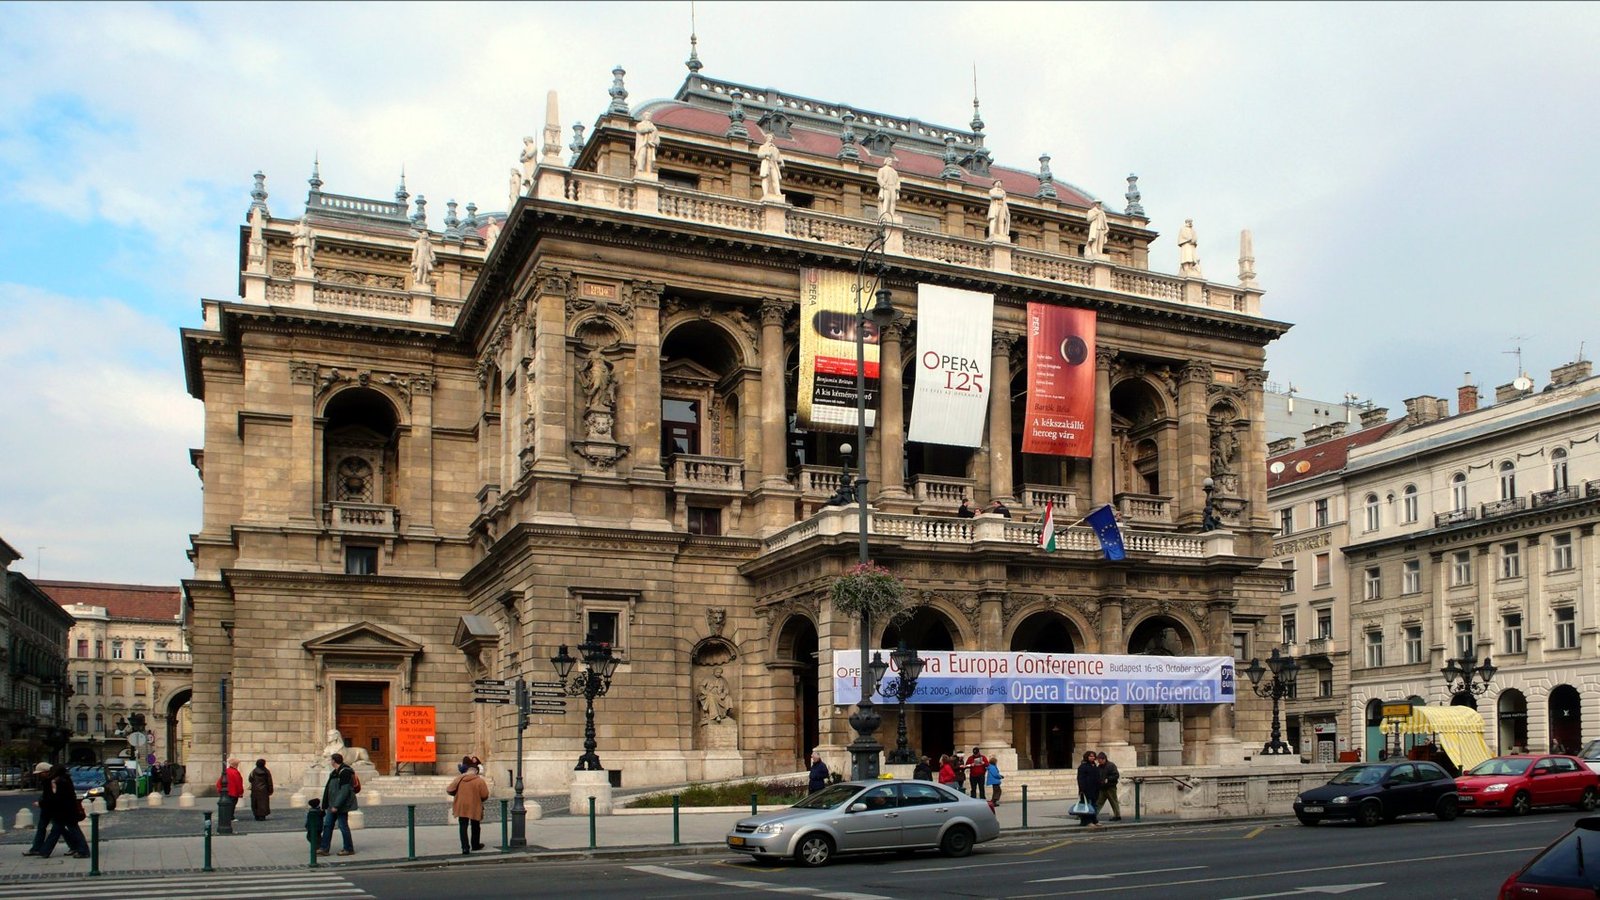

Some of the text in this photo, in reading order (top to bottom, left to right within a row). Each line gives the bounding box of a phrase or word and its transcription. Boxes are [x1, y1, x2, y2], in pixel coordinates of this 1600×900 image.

[923, 351, 979, 373] OPERA
[944, 370, 983, 392] 125
[1033, 428, 1074, 440] herceg vára
[837, 667, 861, 678] OPE
[890, 654, 940, 672] Ora
[949, 653, 1008, 678] Europa
[1016, 654, 1104, 675] Conference
[1110, 663, 1142, 673] Budapest
[1145, 664, 1163, 672] 16-18
[1166, 664, 1191, 673] October
[1194, 666, 1210, 674] 2009
[930, 686, 952, 696] 2009.
[954, 685, 984, 695] október
[1011, 680, 1058, 703] Opera
[1066, 681, 1118, 704] Europa
[1127, 682, 1211, 700] Konferencia
